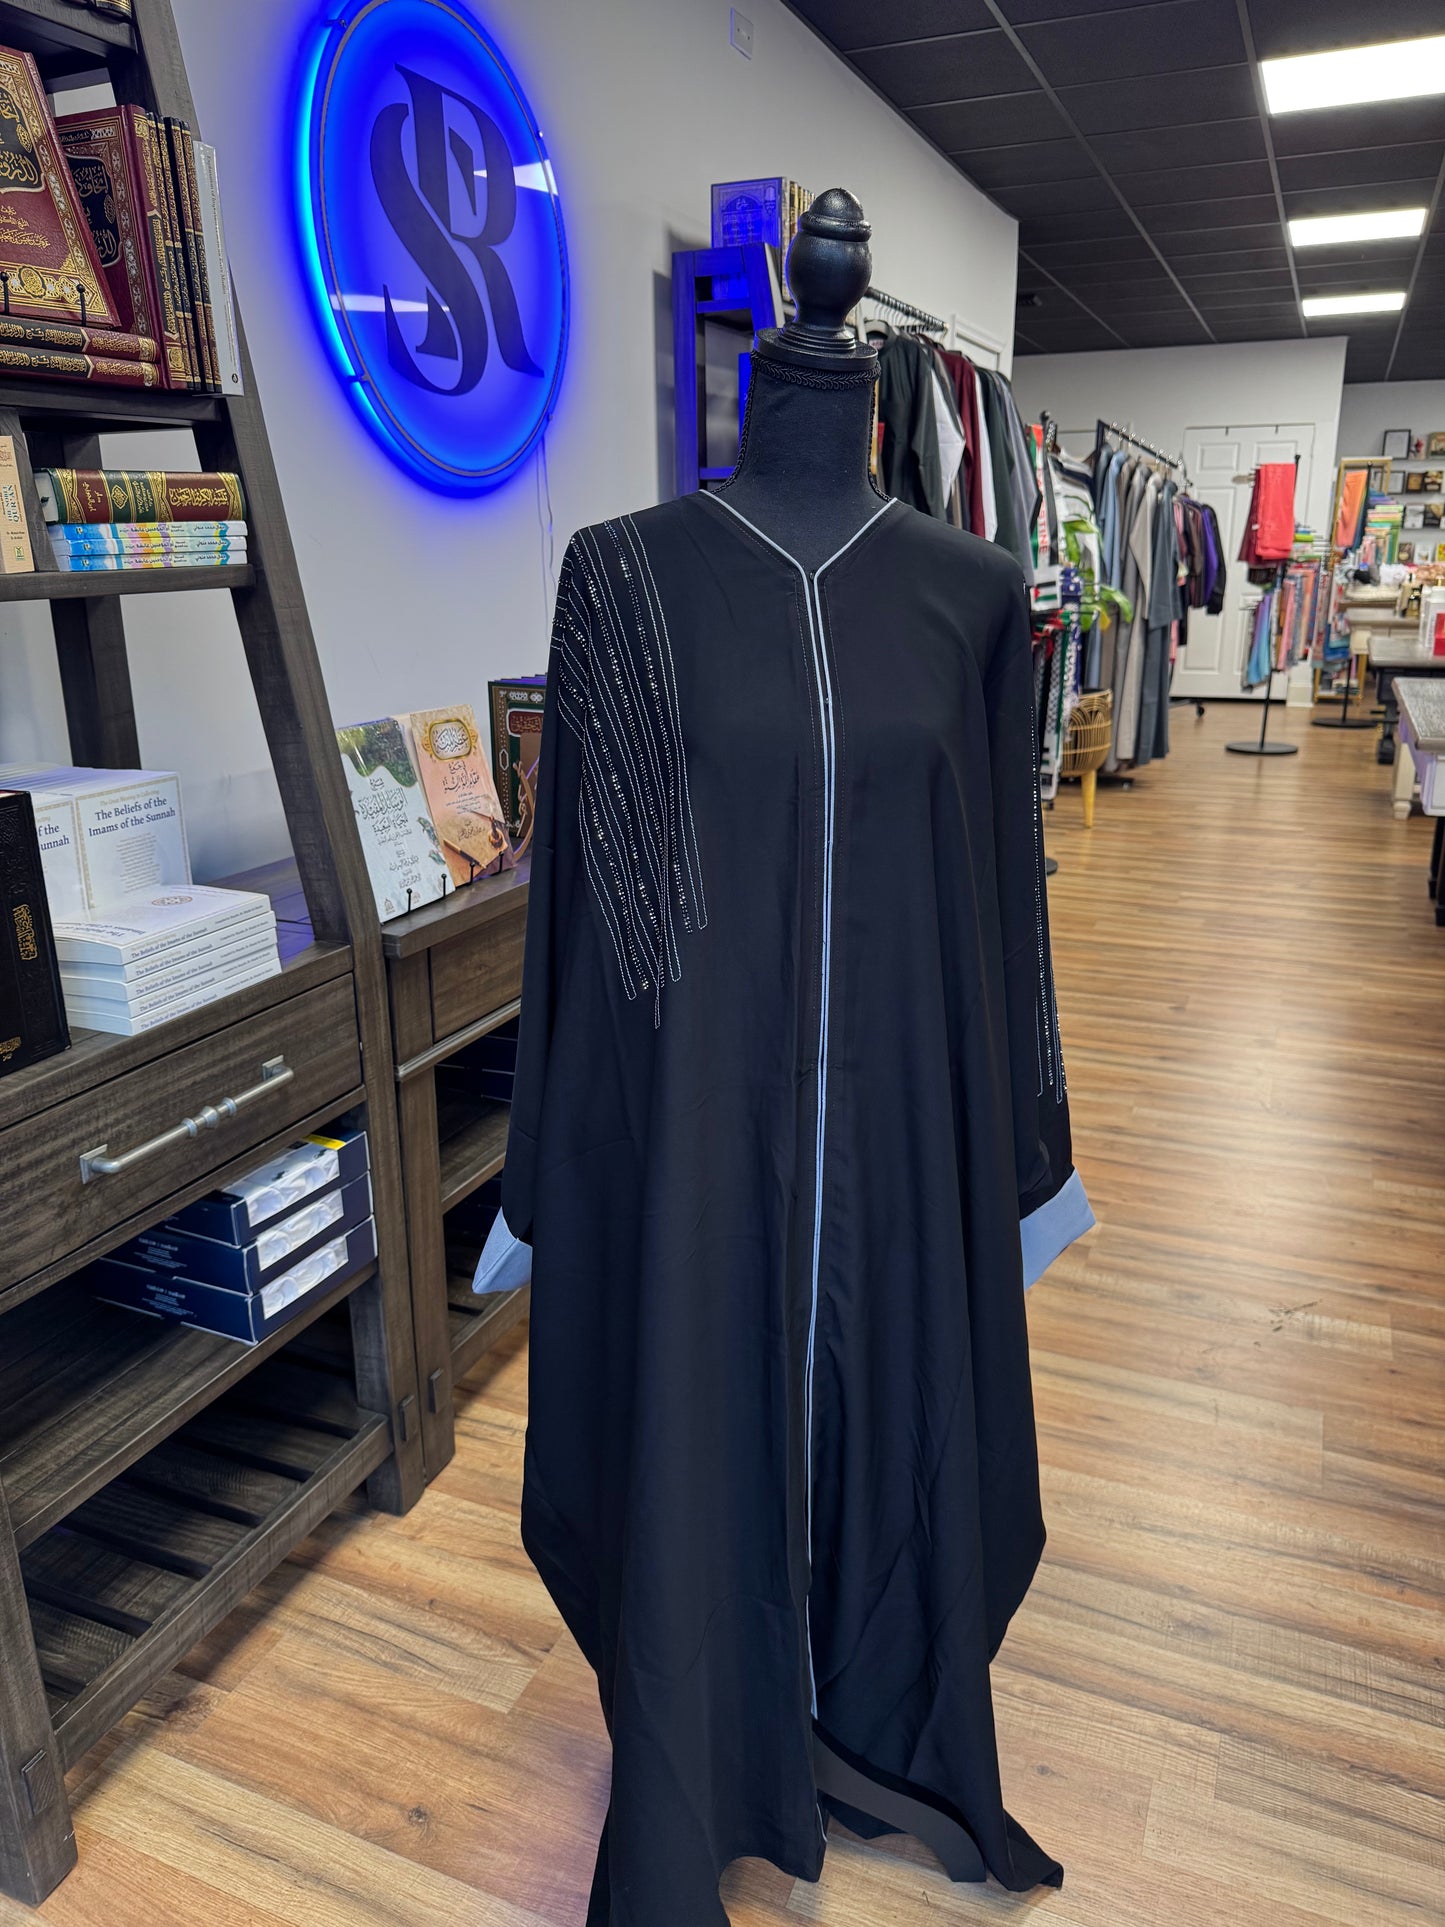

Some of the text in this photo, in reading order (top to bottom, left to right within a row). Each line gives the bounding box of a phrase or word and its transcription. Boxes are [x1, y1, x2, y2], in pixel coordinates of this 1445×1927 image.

[95, 796, 167, 821] The Beliefs of the
[44, 823, 60, 835] the
[88, 807, 176, 837] Imams of the Sunnah
[40, 834, 70, 851] unnah
